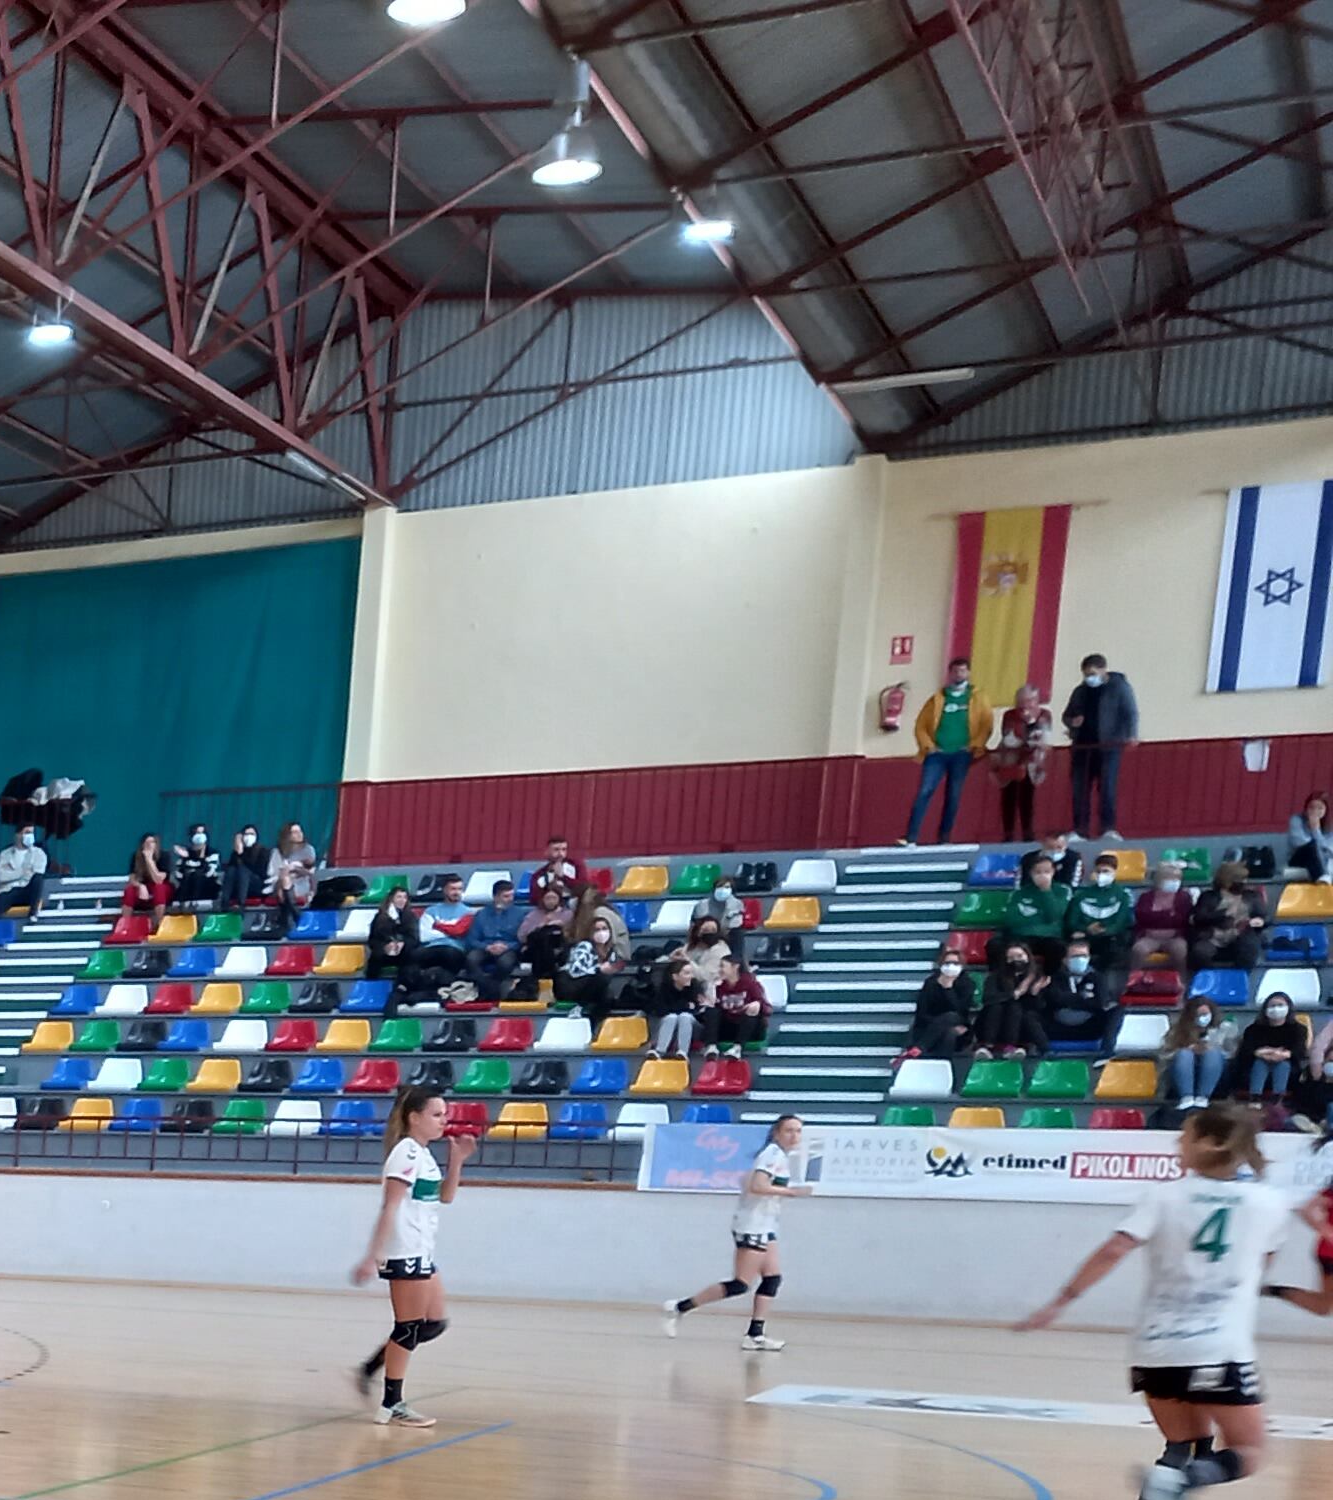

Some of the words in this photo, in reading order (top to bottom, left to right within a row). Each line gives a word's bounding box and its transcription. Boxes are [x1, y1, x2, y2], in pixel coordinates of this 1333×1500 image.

[982, 1153, 1067, 1171] etimed
[1075, 1154, 1183, 1179] PIKOLINOS
[1192, 1207, 1233, 1263] 4
